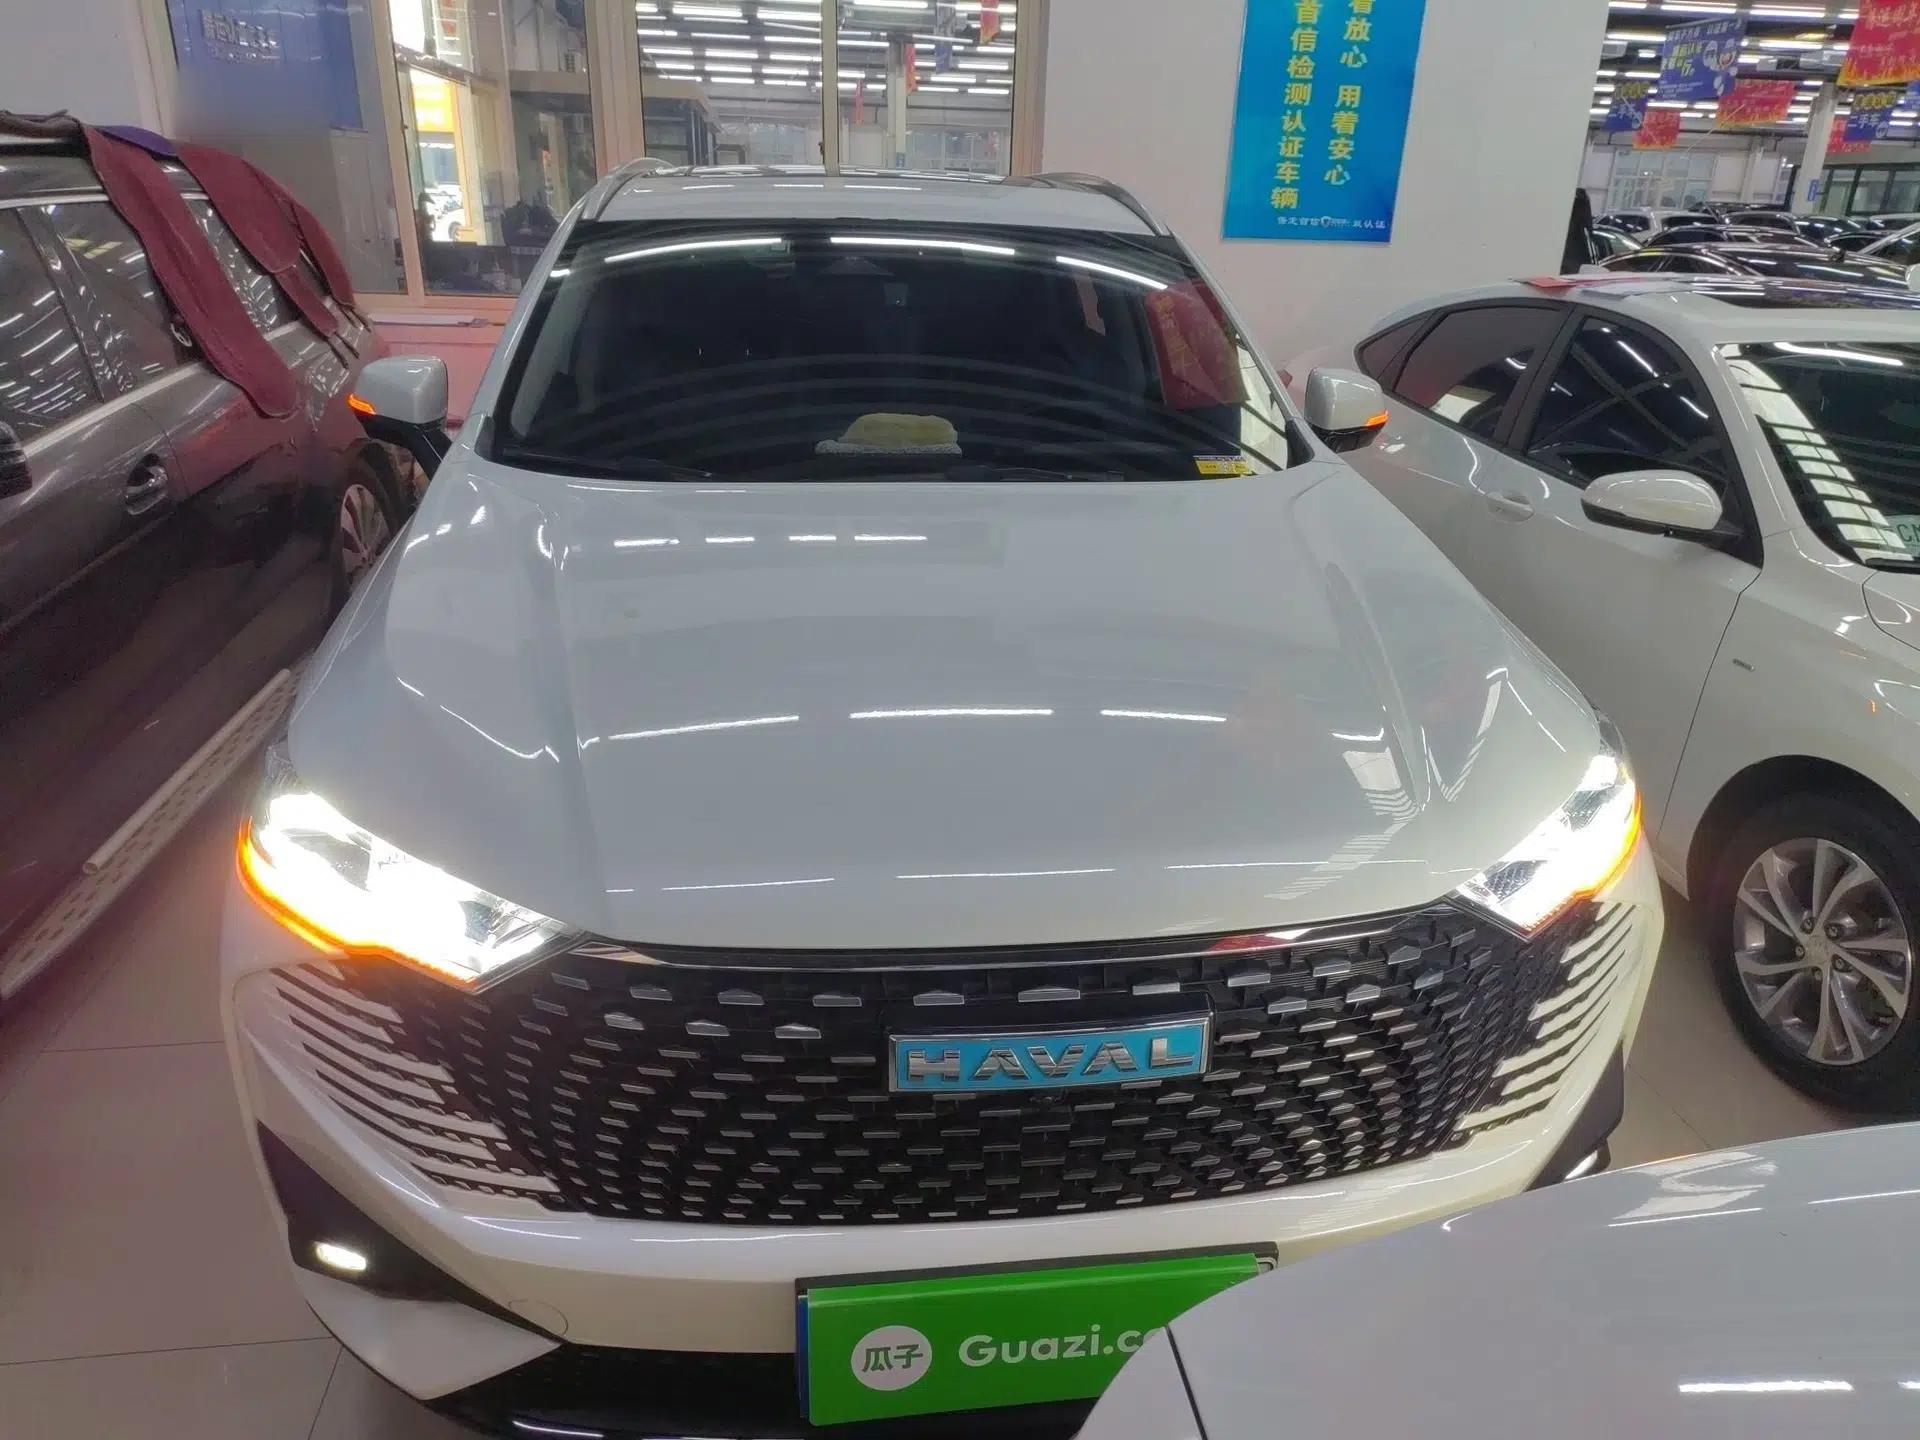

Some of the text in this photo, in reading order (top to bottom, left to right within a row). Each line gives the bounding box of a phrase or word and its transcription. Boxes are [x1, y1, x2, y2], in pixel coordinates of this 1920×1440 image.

[1323, 85, 1361, 185] 用着安心
[908, 1037, 1195, 1082] HAVAL
[861, 1324, 1162, 1373] 瓜子 Guazi.c
